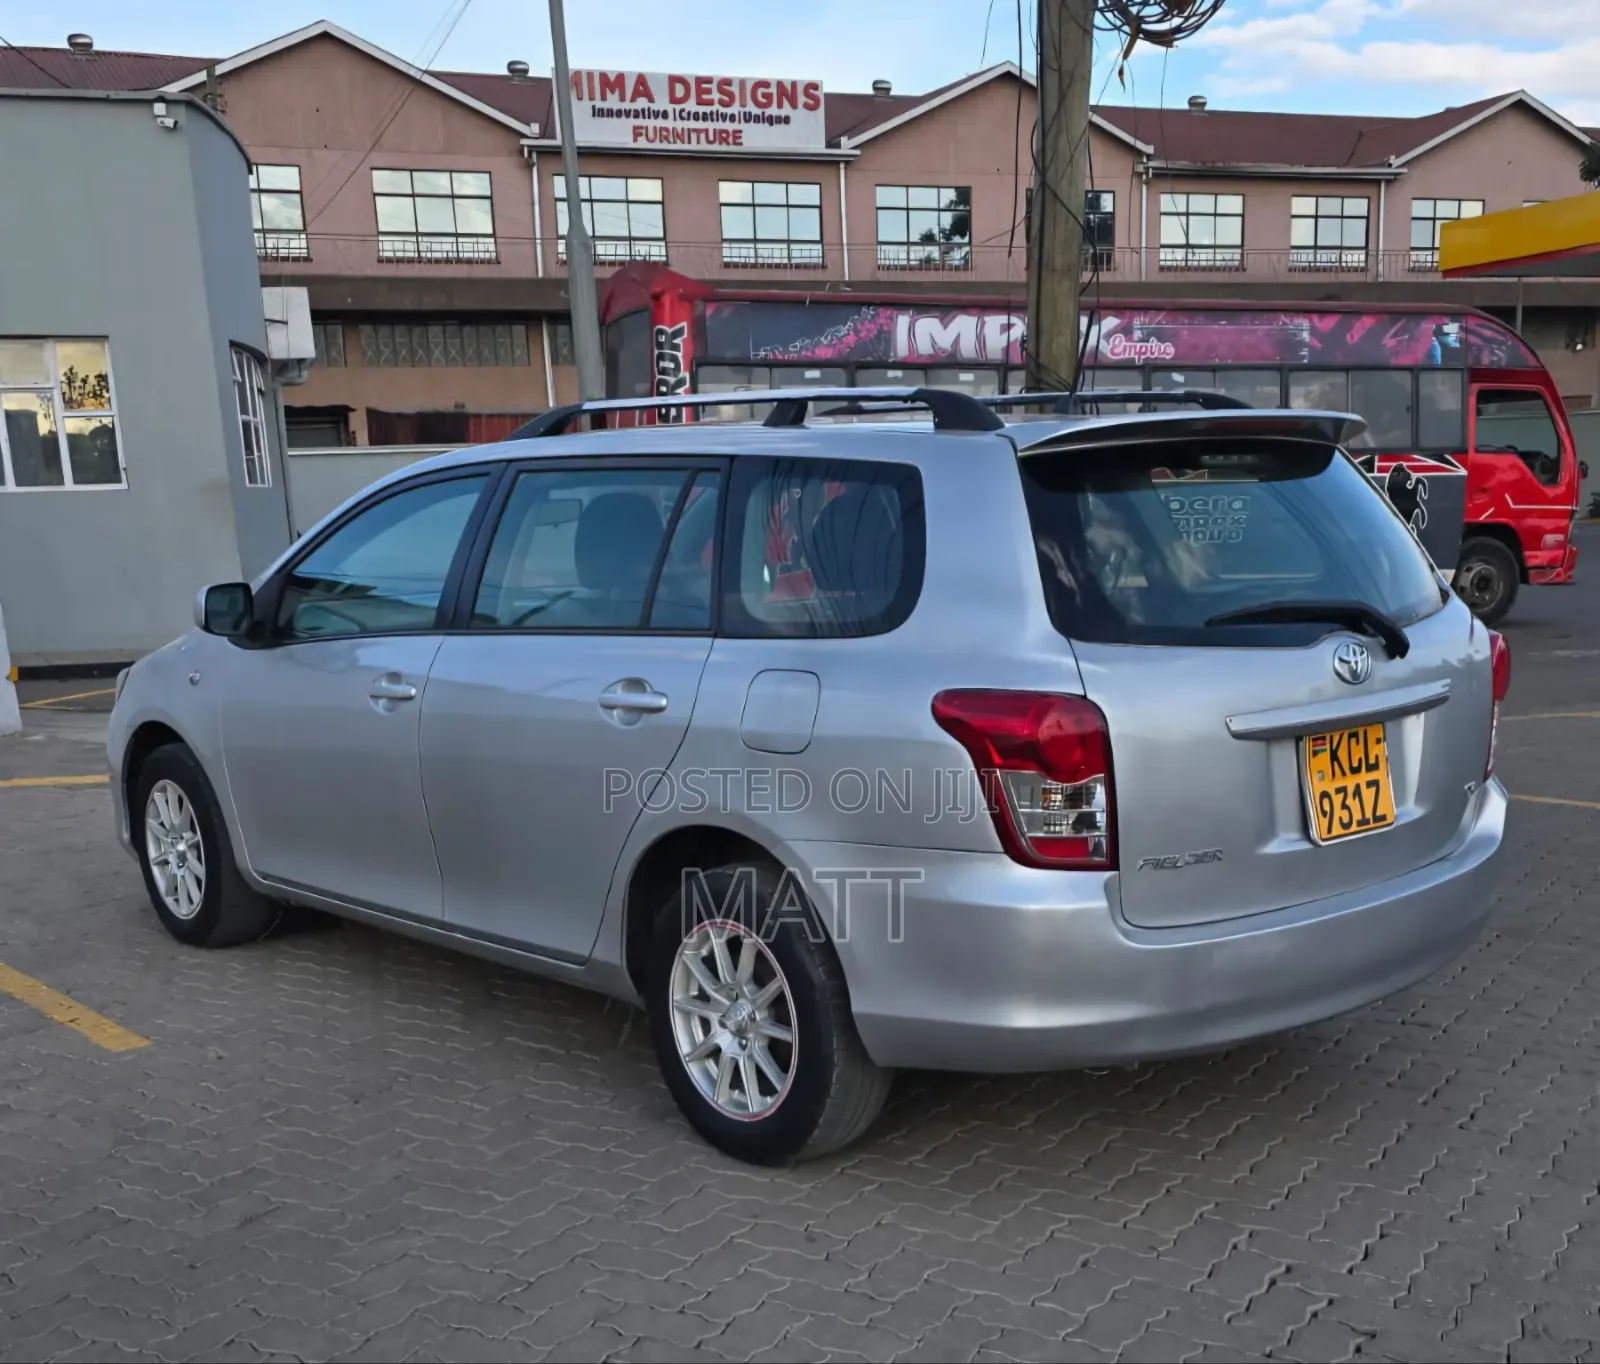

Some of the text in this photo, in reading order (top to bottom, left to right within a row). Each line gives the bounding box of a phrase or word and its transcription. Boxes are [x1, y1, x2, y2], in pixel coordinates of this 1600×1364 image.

[667, 74, 821, 111] DESIGNS
[591, 104, 669, 120] Innovative
[632, 125, 743, 146] FURNITURE
[1109, 333, 1175, 365] Empire
[1329, 728, 1380, 780] KCL
[1318, 778, 1388, 835] 931Z
